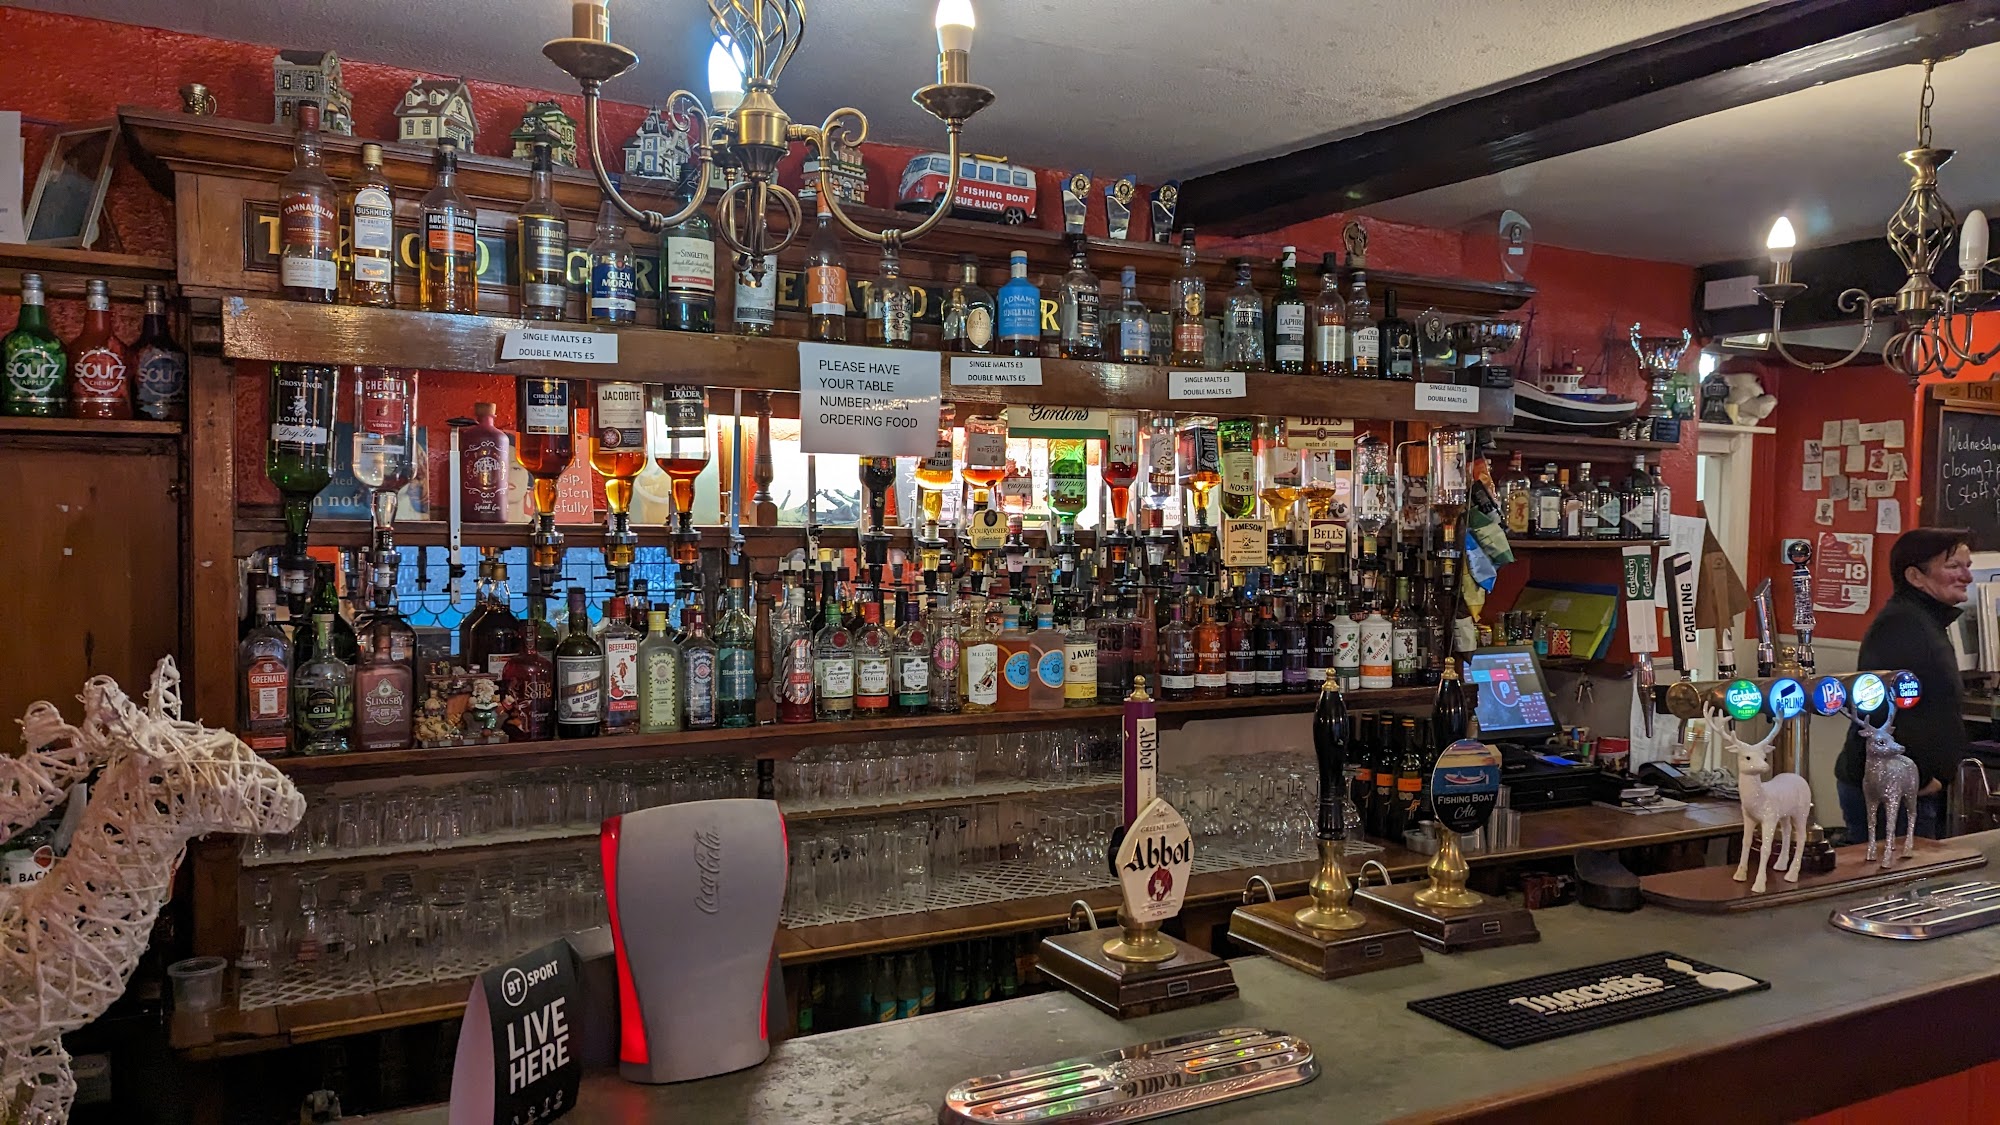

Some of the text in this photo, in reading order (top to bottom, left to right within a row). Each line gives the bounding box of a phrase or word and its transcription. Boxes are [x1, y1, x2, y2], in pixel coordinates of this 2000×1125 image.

[955, 196, 973, 206] SUE
[963, 186, 1002, 199] FISHING
[1006, 193, 1030, 204] BOAT
[284, 203, 335, 220] TAMNAVULIN
[356, 206, 392, 217] BUSHMILLS
[607, 271, 631, 282] GLEN
[601, 279, 634, 290] MORAY
[1003, 294, 1035, 306] ADNAMS
[1078, 294, 1099, 303] JURA
[522, 332, 592, 344] SINGLE MALTS £3
[519, 348, 594, 360] DOUBLE MALTS £5
[819, 359, 900, 375] PLEASE HAVE
[969, 360, 991, 368] SINGLE
[279, 379, 323, 389] GROSVENOR
[1018, 374, 1026, 382] £5
[365, 380, 401, 391] CHEKOV
[819, 377, 894, 392] YOUR TABLE
[602, 390, 641, 401] JACOBITE
[669, 389, 702, 400] TRADER
[1447, 396, 1462, 404] MALTS
[820, 395, 871, 408] NUMBER
[279, 415, 320, 425] LONDON
[820, 413, 918, 428] ORDERING FOOD
[329, 493, 361, 507] not
[970, 527, 1008, 535] COURVOISIER
[1230, 522, 1263, 533] JAMESON
[1313, 527, 1344, 540] BELL'S
[1849, 542, 1864, 555] 21
[1626, 556, 1640, 598] Carlsberg
[1642, 556, 1653, 598] Carlsberg
[1844, 563, 1866, 580] 18
[1682, 582, 1696, 643] CARLING
[608, 642, 637, 652] BEEFEATER
[1371, 643, 1389, 660] WHITLEY
[251, 675, 286, 684] GREENALL'S
[1729, 685, 1762, 706] Carlsberg
[1822, 684, 1844, 703] IPA
[366, 696, 404, 708] SLINGSBY
[313, 706, 331, 714] GIN
[1139, 726, 1156, 771] Abbot
[1438, 794, 1494, 805] FISHING BOAT
[1454, 804, 1477, 820] Ale
[1141, 824, 1165, 833] GREENE
[1123, 836, 1192, 872] Abbot
[507, 960, 558, 997] BT SPORT
[1508, 973, 1665, 1013] THATCHERS
[507, 996, 569, 1061] LIVE
[510, 1033, 570, 1095] HERE
